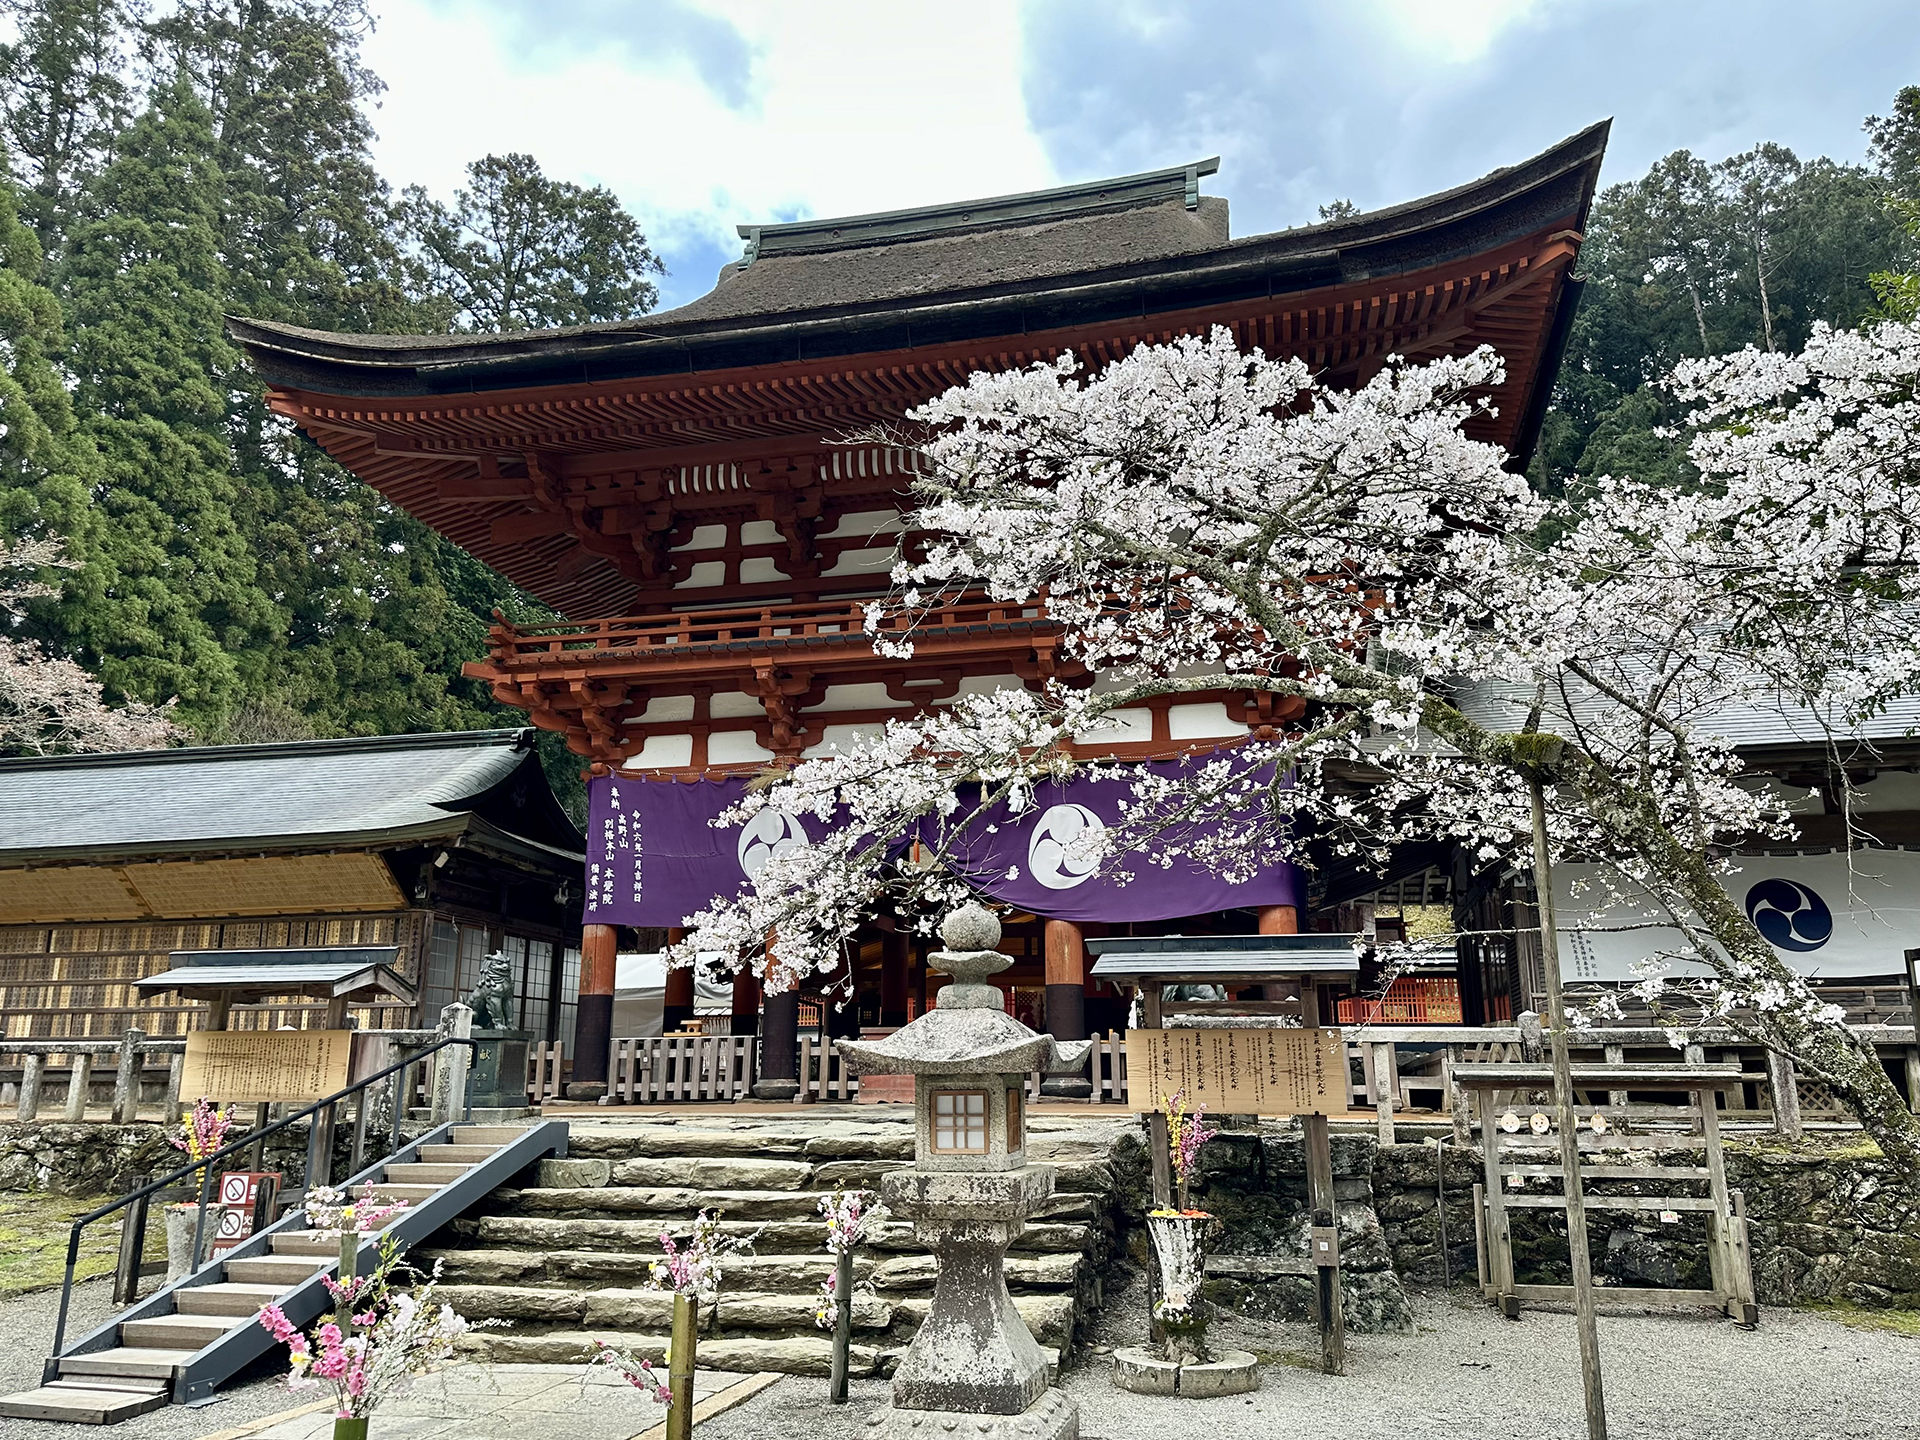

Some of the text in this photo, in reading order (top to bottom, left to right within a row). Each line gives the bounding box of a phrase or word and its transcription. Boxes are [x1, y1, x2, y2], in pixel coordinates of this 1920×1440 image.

[610, 786, 621, 810] 奉納
[604, 819, 616, 861] 別格本山
[618, 813, 630, 849] 高野山
[632, 810, 643, 902] 令和六年一月吉祥日
